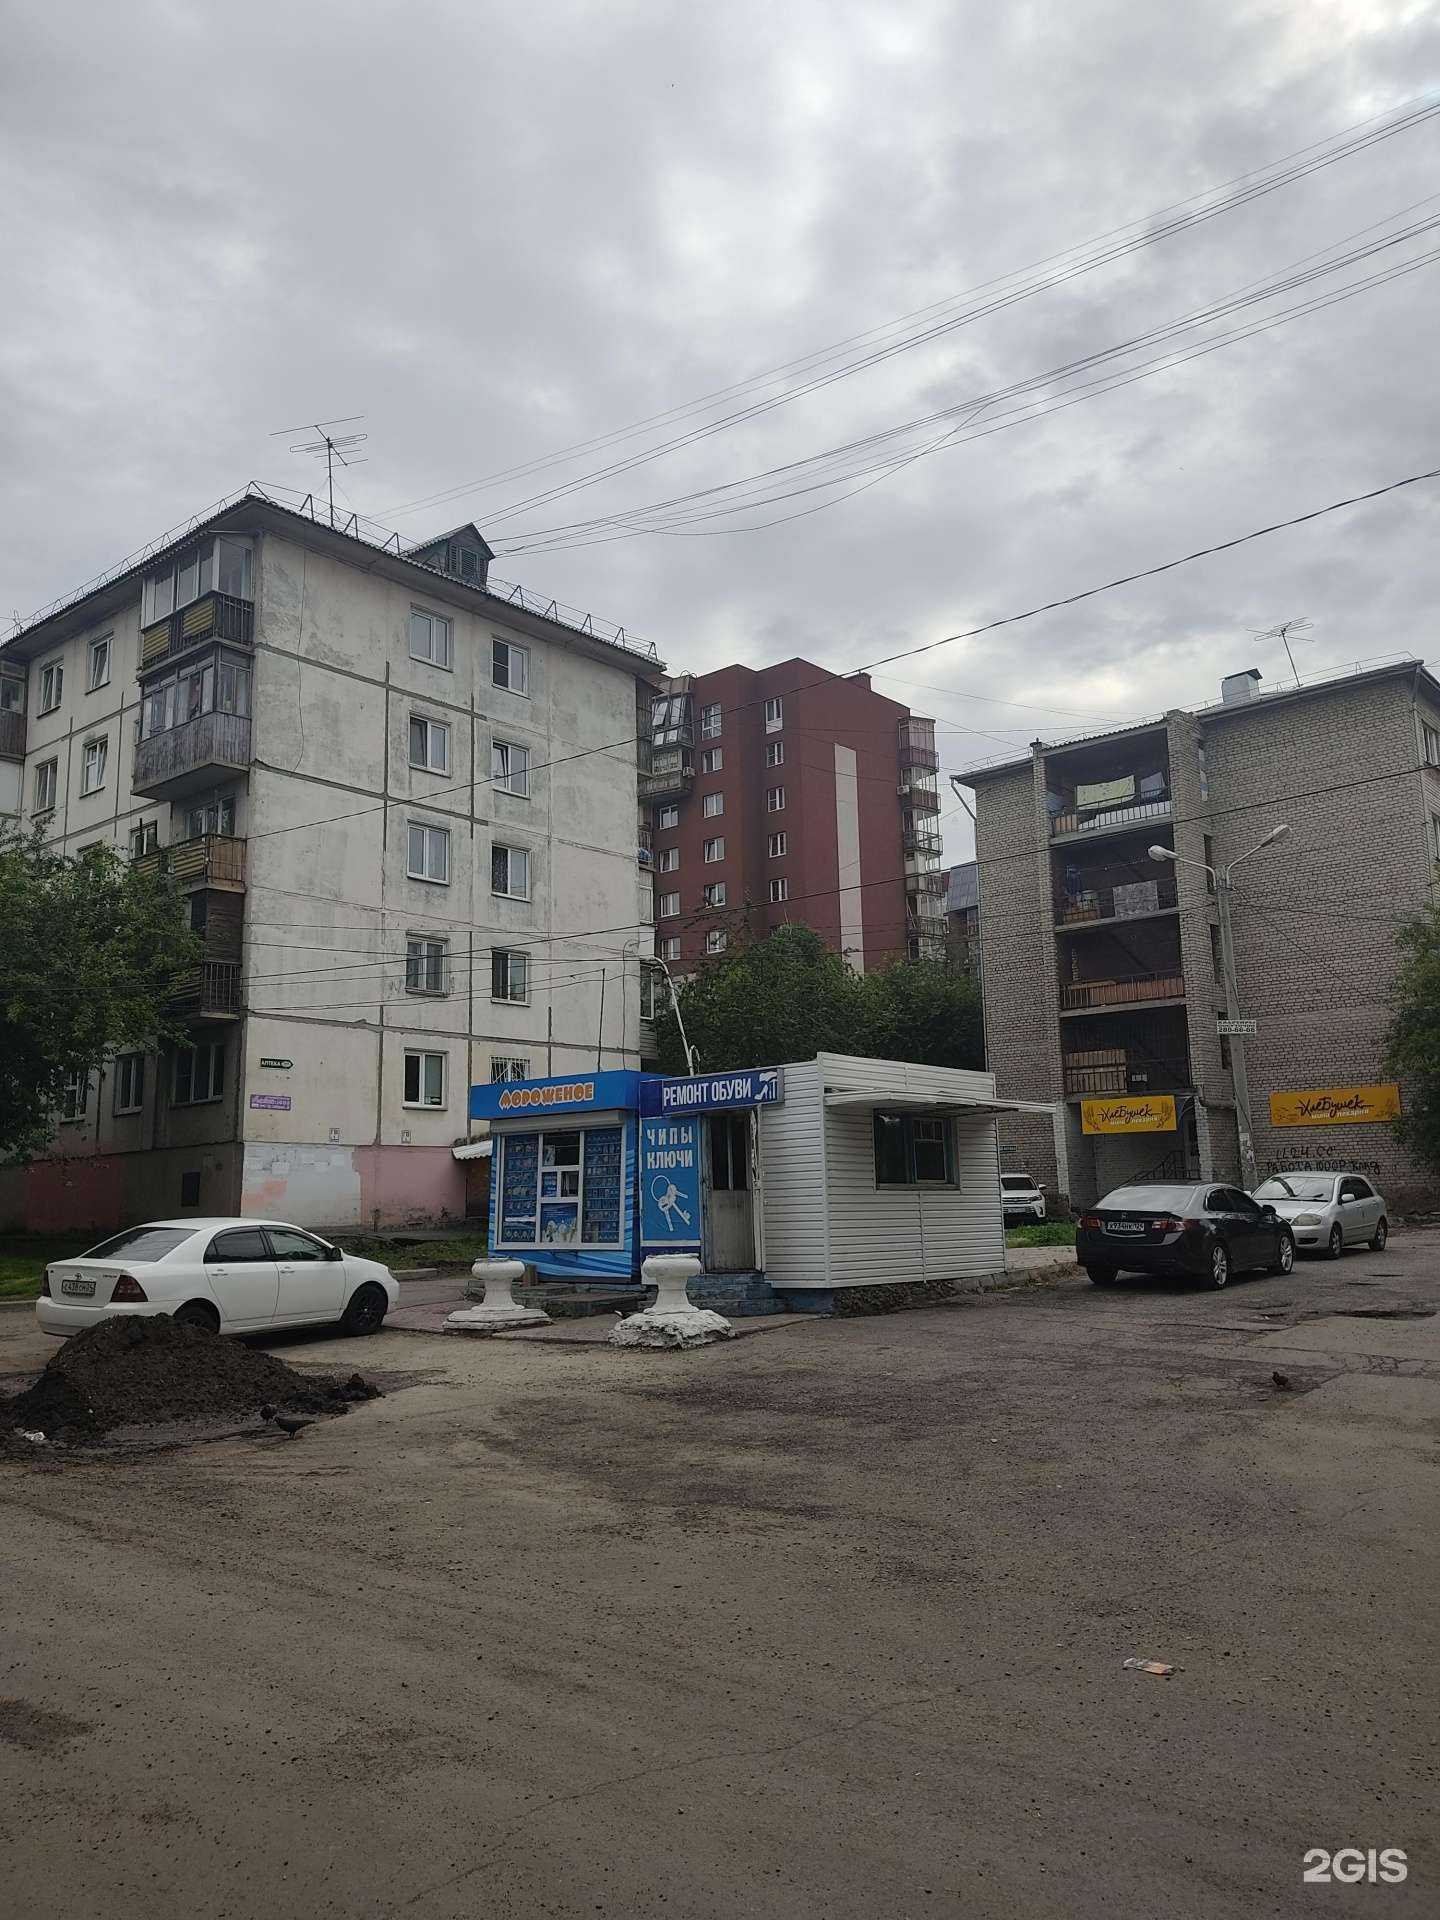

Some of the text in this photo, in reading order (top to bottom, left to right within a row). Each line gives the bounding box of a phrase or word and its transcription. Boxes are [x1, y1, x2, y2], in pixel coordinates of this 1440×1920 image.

[499, 1082, 594, 1110] МОРОЖЕНОЕ
[663, 1078, 752, 1107] РЕМОНТ ОБУВИ
[647, 1126, 693, 1147] ЧИПЫ
[647, 1150, 693, 1170] КЛЮЧИ
